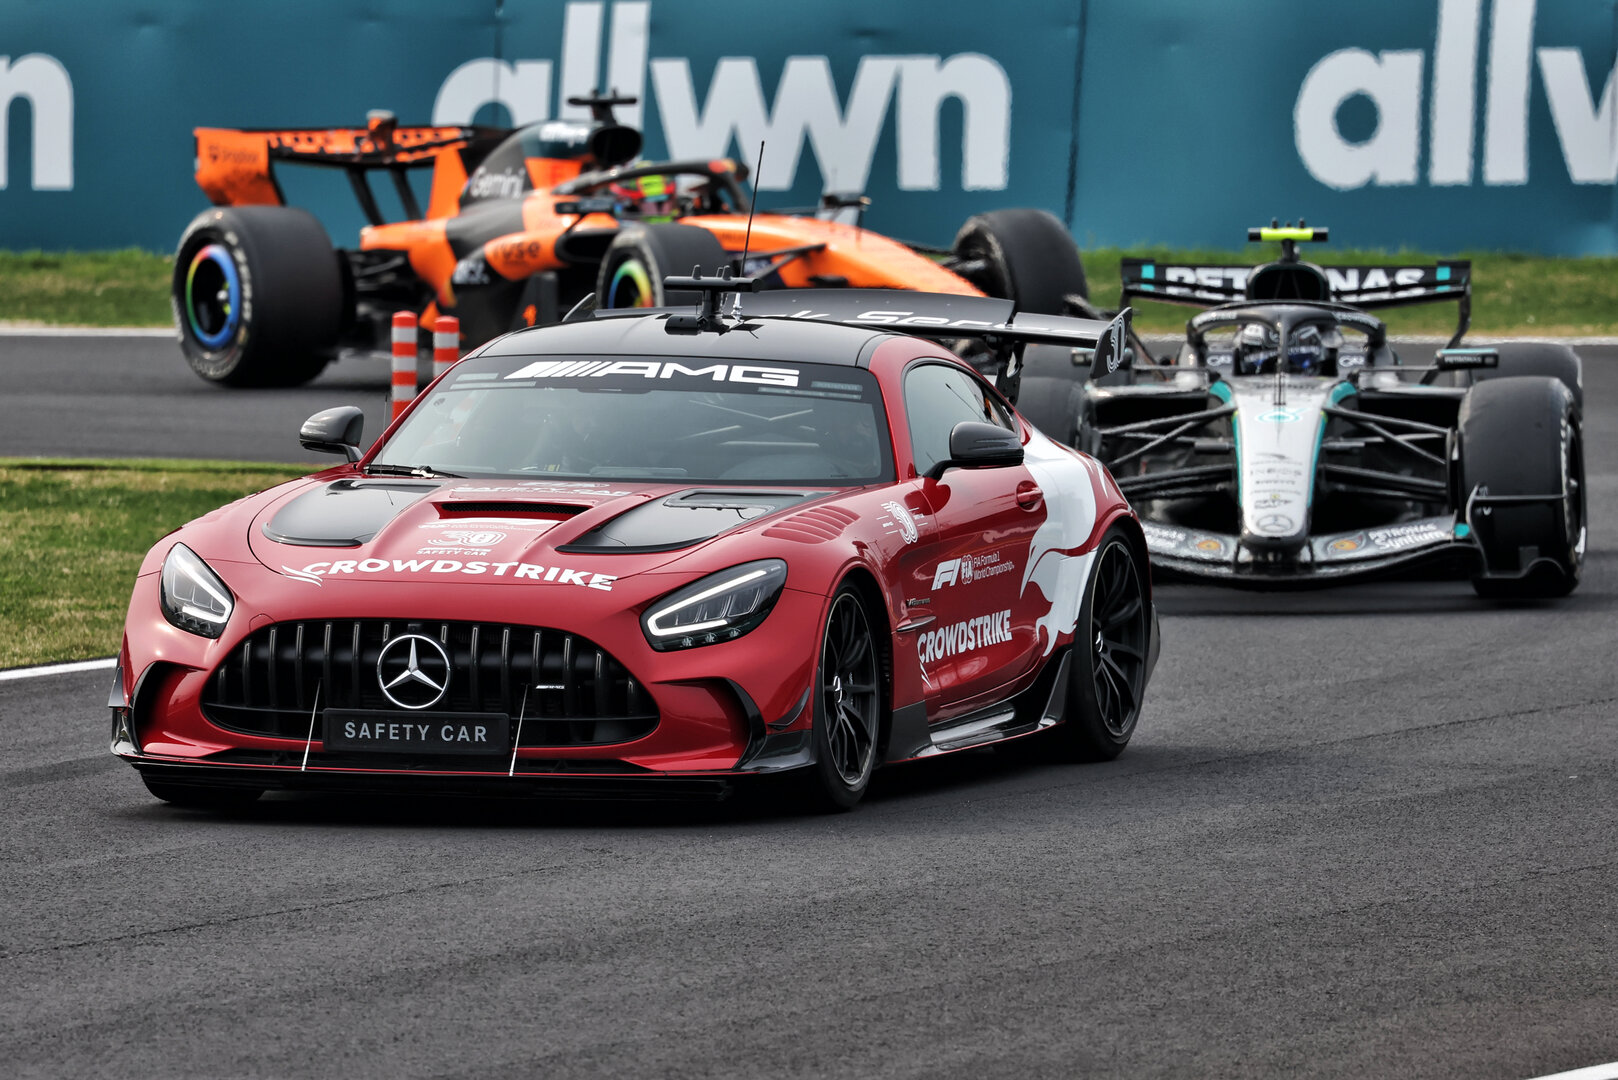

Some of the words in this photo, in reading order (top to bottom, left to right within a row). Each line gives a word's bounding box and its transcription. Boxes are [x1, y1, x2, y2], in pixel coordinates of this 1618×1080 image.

[470, 166, 525, 199] Gemini
[1165, 268, 1426, 301] PETNAS
[1106, 314, 1126, 373] 30
[597, 361, 799, 387] AMG
[1367, 522, 1438, 541] PETRONAS
[302, 558, 618, 592] CROWDSTRIKE
[931, 557, 962, 591] F1
[961, 559, 974, 579] FIA
[917, 609, 1013, 664] CROWDSTRIKE
[344, 721, 430, 742] SAFETY
[440, 725, 488, 743] CAR
